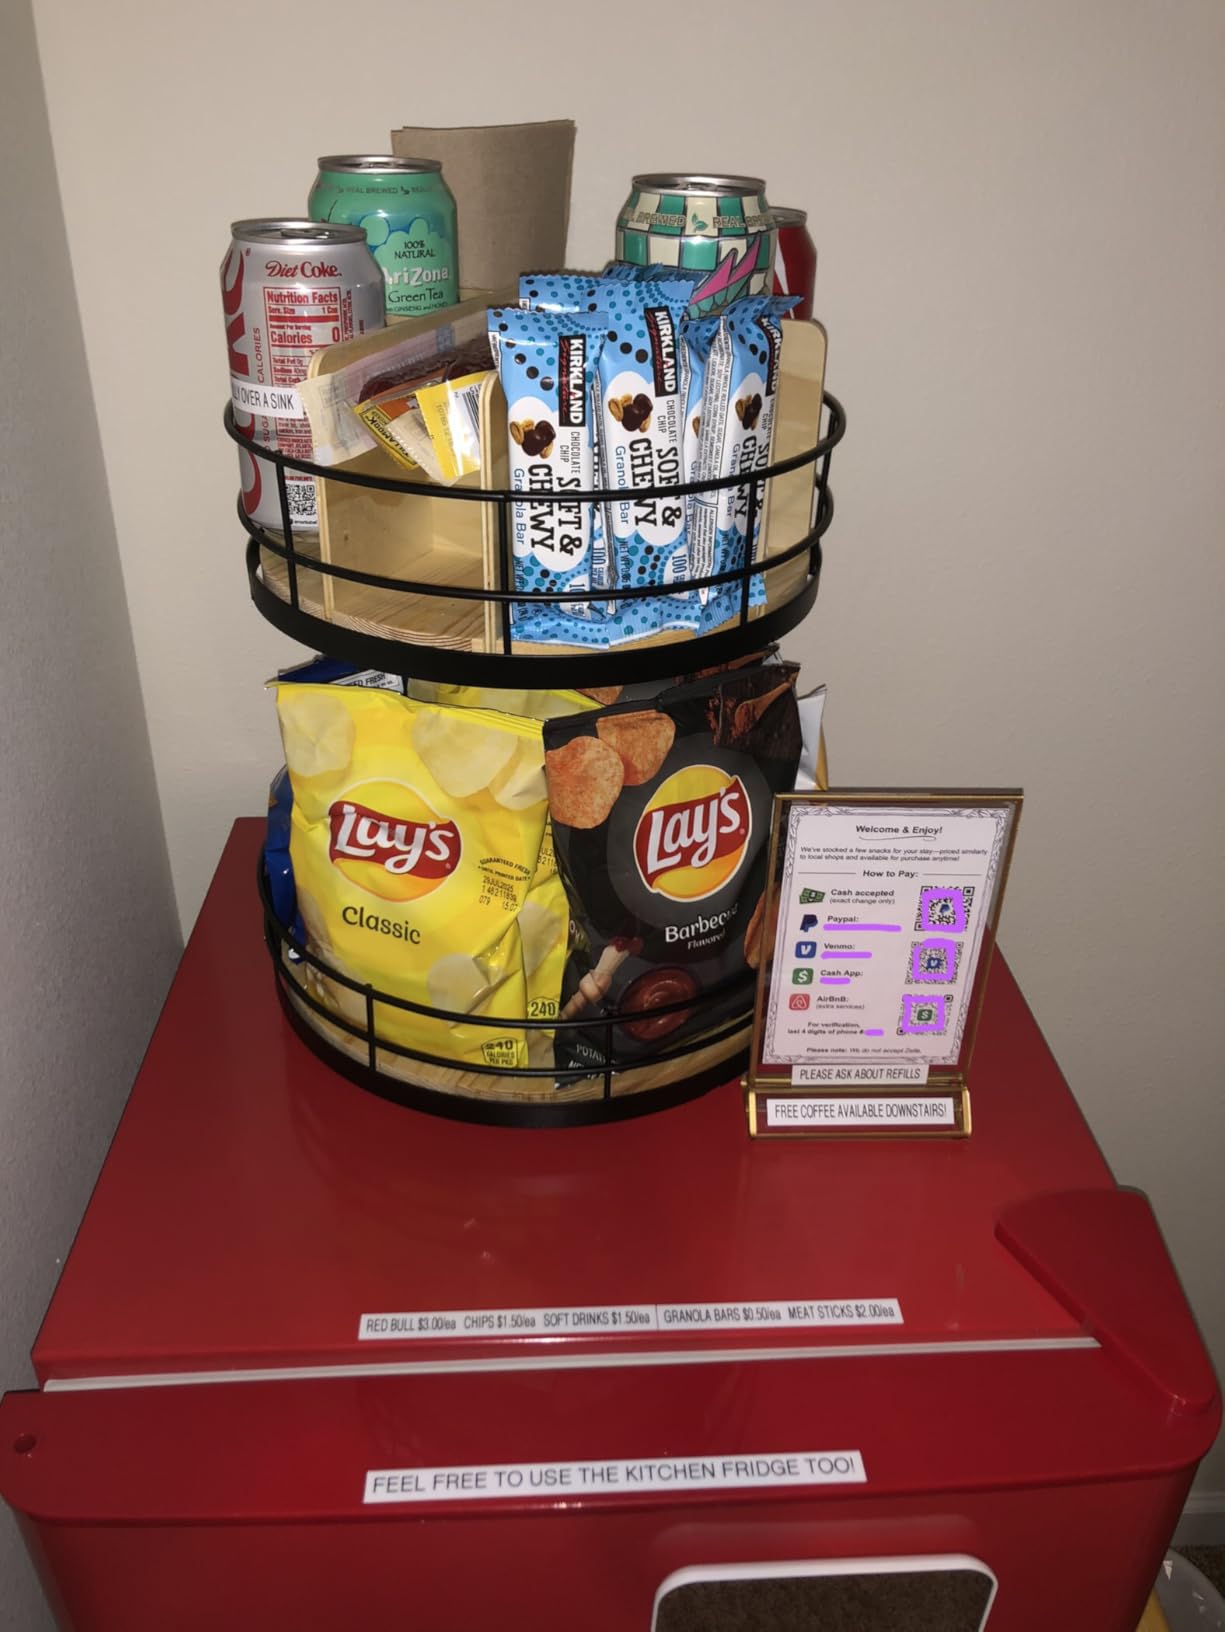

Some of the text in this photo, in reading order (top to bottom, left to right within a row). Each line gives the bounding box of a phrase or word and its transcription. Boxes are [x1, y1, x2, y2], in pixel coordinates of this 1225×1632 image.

[636, 211, 687, 228] BREWED
[713, 216, 745, 228] REAL
[394, 248, 437, 260] NATURAL
[404, 240, 425, 250] 100%
[265, 260, 299, 279] Diet
[267, 290, 338, 304] Nutrition Facts
[388, 287, 445, 303] Green Tea
[270, 326, 340, 344] Calories 0
[252, 327, 265, 384] CALORIES
[654, 310, 677, 392] KIRKLAND
[568, 338, 584, 425] KIRKLAND
[241, 387, 262, 407] OVER
[263, 392, 270, 408] A
[271, 392, 295, 411] SINK
[657, 415, 667, 433] CHIP
[666, 399, 678, 443] CHOCOLATE
[559, 444, 570, 463] CHIP
[570, 431, 581, 474] CHOCOLATE
[615, 445, 631, 524] Granol Bar
[655, 447, 682, 529] SOF &
[726, 443, 741, 518] Grana Bar
[513, 468, 527, 545] Graola Bar
[556, 477, 583, 556] SFT &
[671, 553, 687, 574] 100
[335, 804, 454, 874] Lay's
[647, 786, 741, 875] Lay's
[856, 825, 943, 836] Welcome & Enjoy!
[514, 864, 530, 875] FRESH
[898, 870, 919, 878] Pay:
[830, 888, 895, 898] Cash accepted
[341, 906, 421, 944] Classic
[827, 915, 860, 924] Paypal:
[530, 1001, 556, 1017] 240
[800, 1068, 922, 1080] PLEASE ASK ABOUT REFILLS
[775, 1103, 947, 1118] FREE COFFEE AVAILABLE DOWNSTAIRS!
[366, 1310, 651, 1333] RED BULL $3.00/ea CHIPS $1.50/ea SOFT DRINKS $1.50/ea
[664, 1302, 895, 1323] GRANOLA BARS $0.50/ea MEAT STICKS $2.00/ea
[373, 1456, 856, 1494] FEEL FREE TO USE THE KITCHEN FRIDGE TOO!
